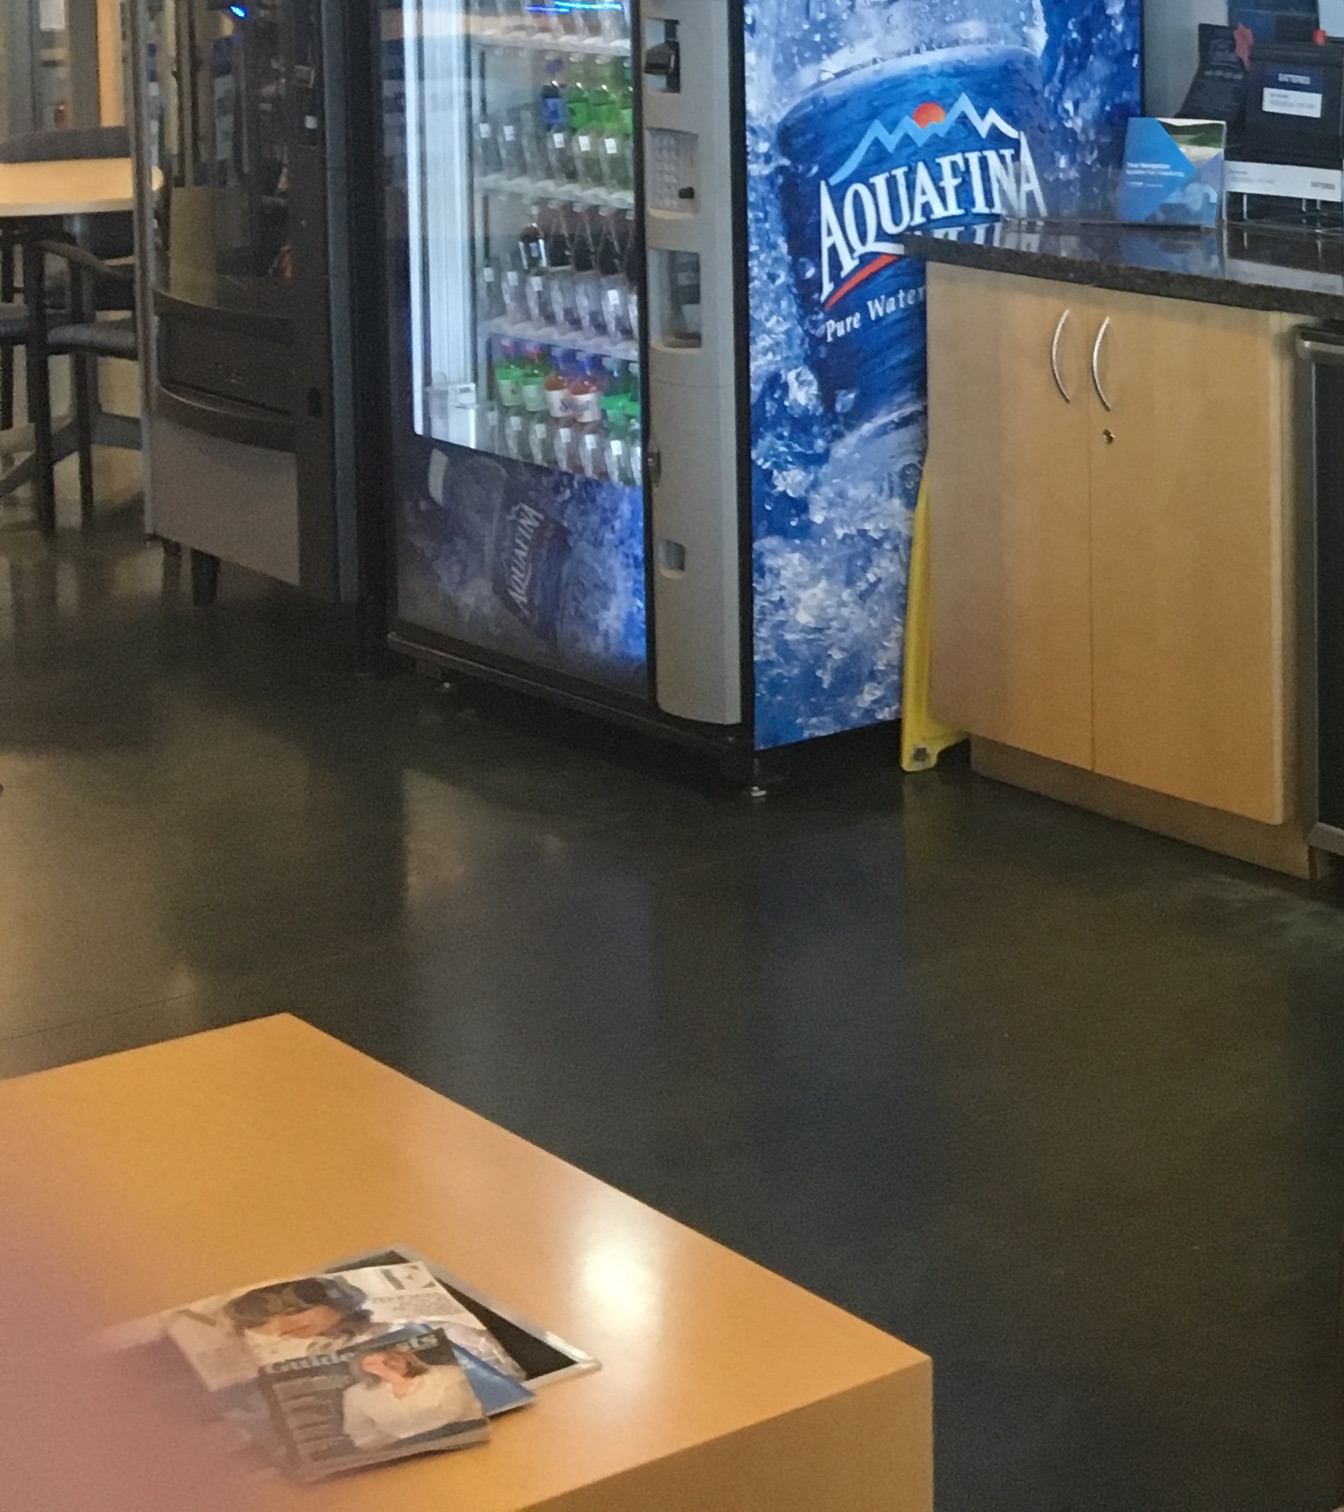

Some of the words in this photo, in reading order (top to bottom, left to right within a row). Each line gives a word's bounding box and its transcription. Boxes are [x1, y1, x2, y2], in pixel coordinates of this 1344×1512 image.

[819, 130, 1048, 304] AQUAFINA
[825, 311, 861, 343] Pure
[866, 285, 927, 321] Water
[506, 502, 545, 616] AQUAFINA
